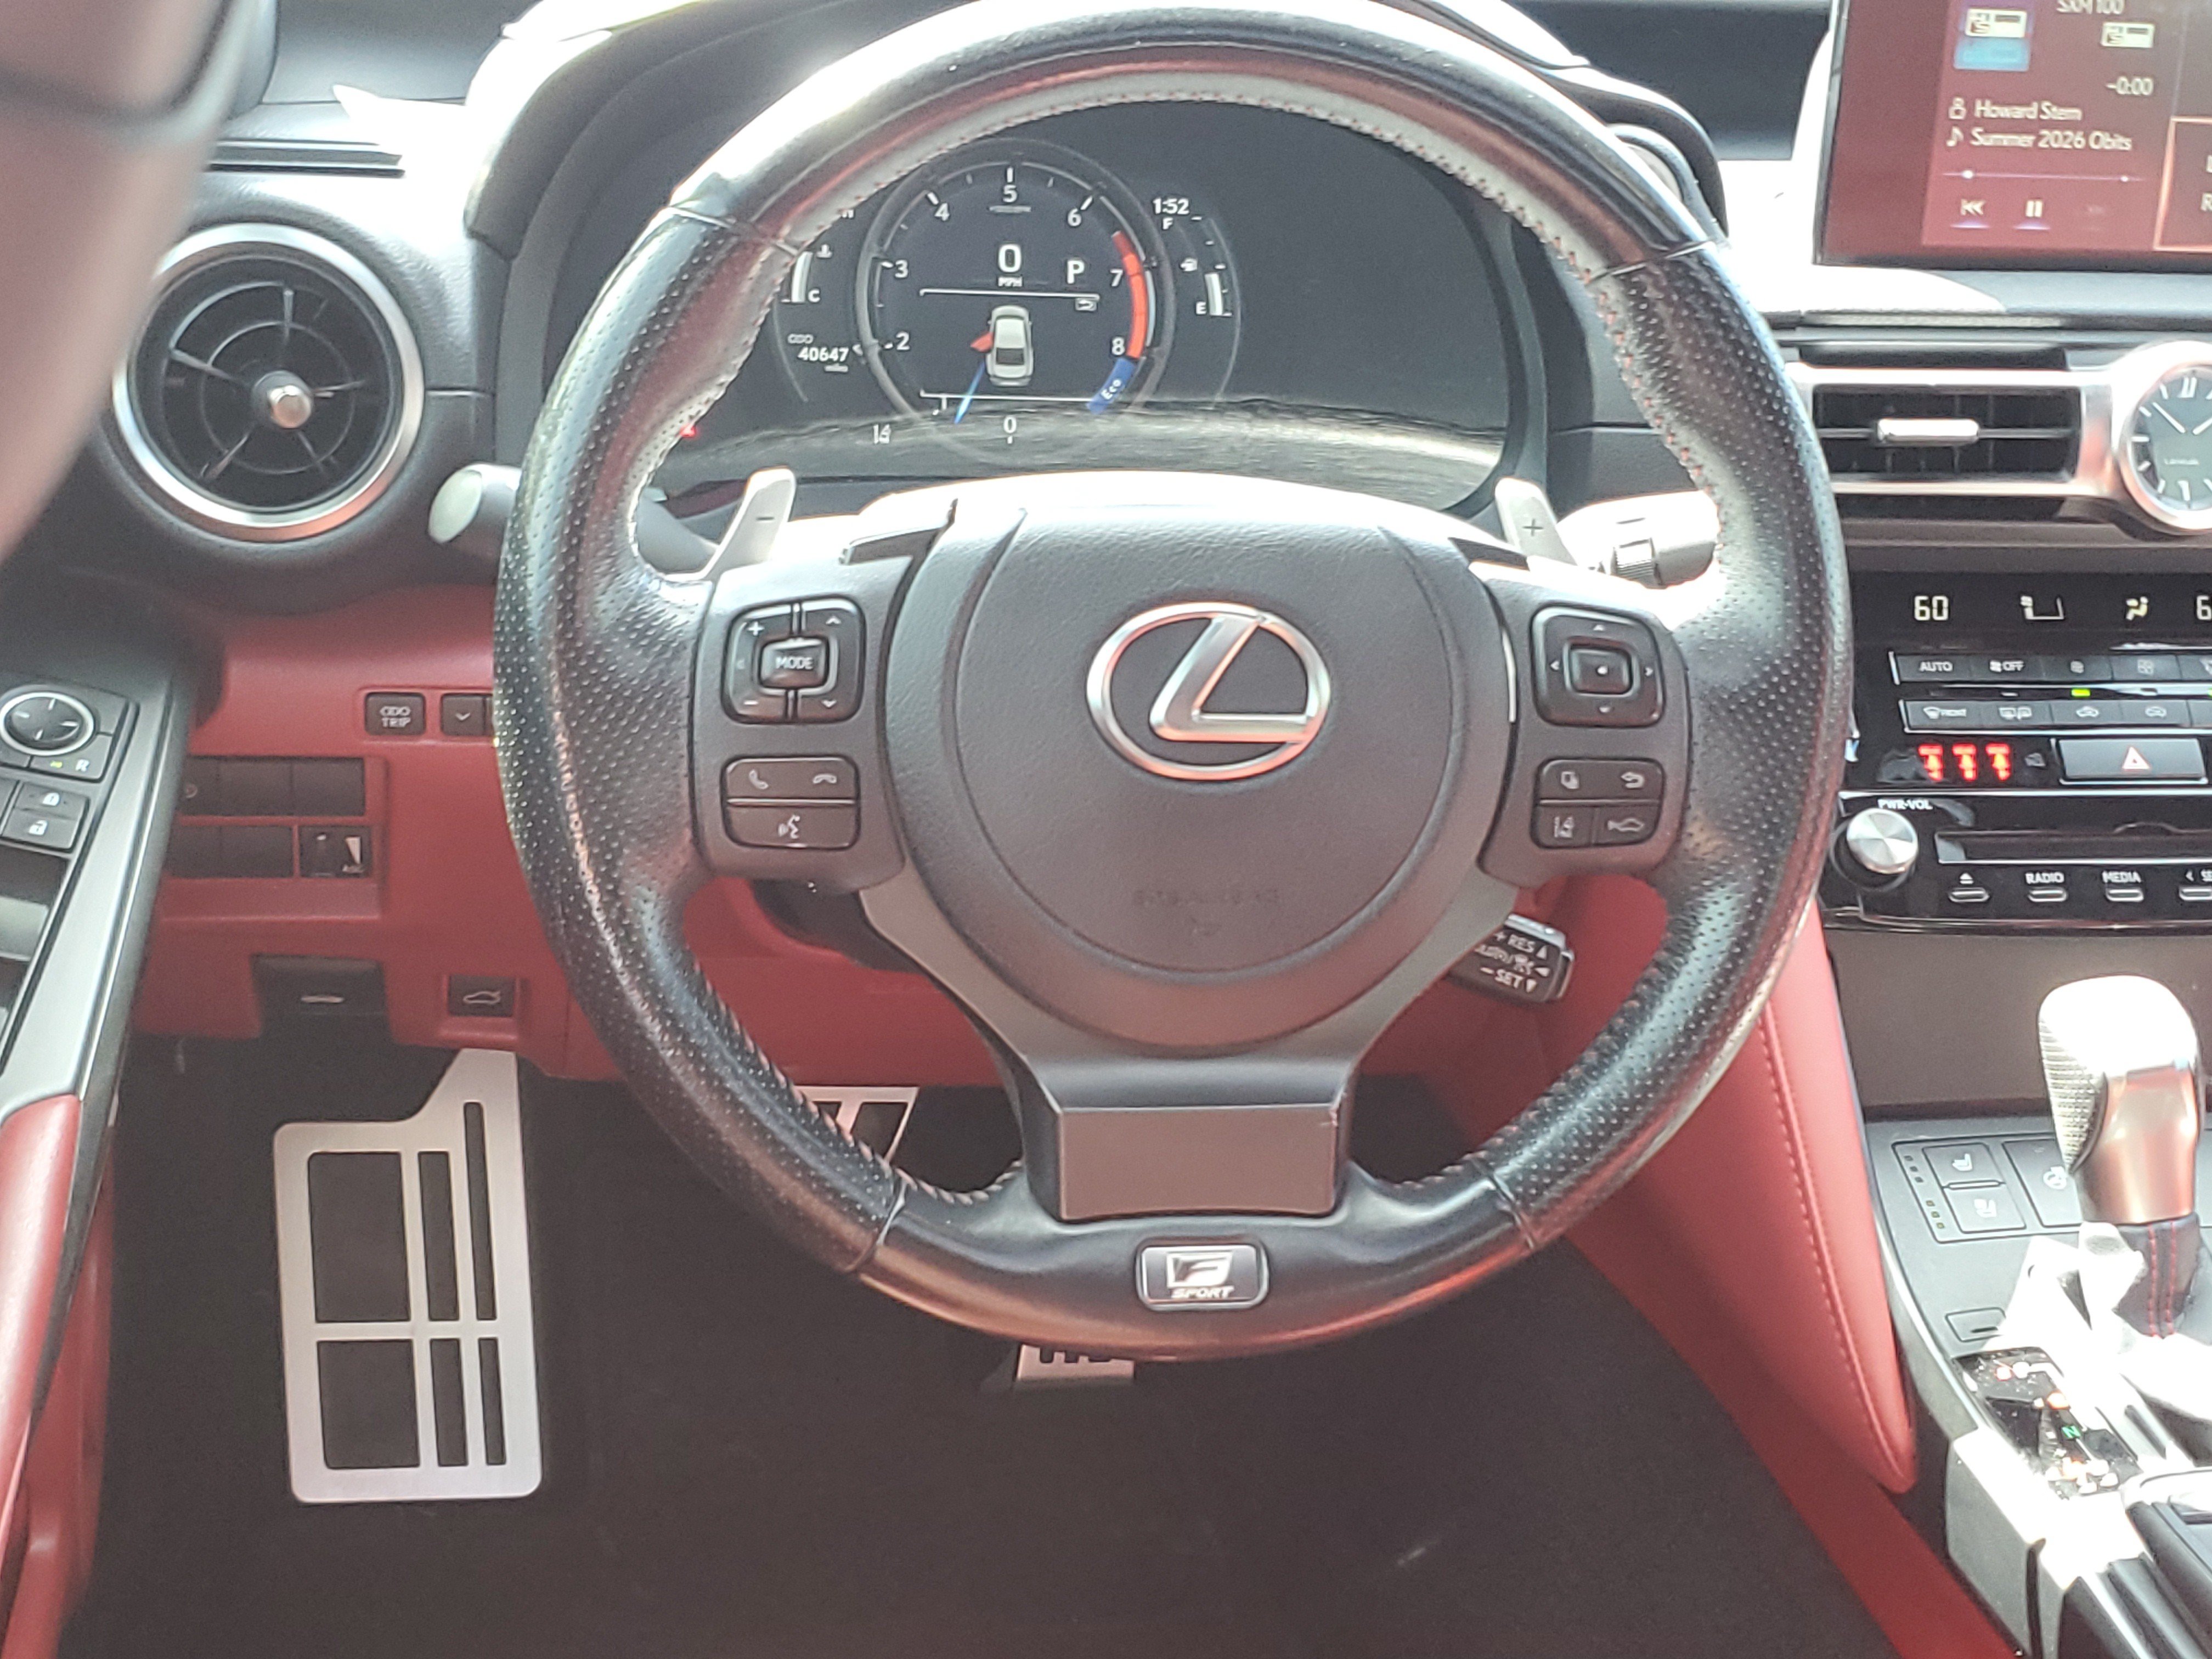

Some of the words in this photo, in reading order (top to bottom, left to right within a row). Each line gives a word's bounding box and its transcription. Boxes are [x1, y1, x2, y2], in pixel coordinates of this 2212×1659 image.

[1974, 99, 2038, 119] Howard
[2039, 100, 2083, 121] Stern
[1970, 127, 2036, 148] Summer
[2038, 129, 2086, 149] 2026
[2089, 131, 2132, 151] Obits
[1002, 184, 1018, 202] 5
[934, 204, 950, 221] 4
[1067, 209, 1082, 226] 6
[1163, 217, 1173, 230] F
[998, 244, 1022, 273] 0
[895, 260, 909, 278] 3
[1066, 260, 1085, 284] P
[1110, 269, 1124, 287] 7
[809, 289, 821, 303] C
[1195, 302, 1206, 315] E
[895, 332, 910, 351] 2
[1111, 337, 1125, 356] 8
[797, 347, 849, 362] 40647
[1003, 417, 1017, 433] 0
[1914, 595, 1949, 621] 60
[775, 656, 814, 670] MODE
[1919, 661, 1953, 672] AUTO
[2002, 661, 2025, 672] OFF
[380, 706, 411, 716] ODO
[381, 716, 411, 728] TRIP
[2025, 871, 2065, 884] RADIO
[2102, 871, 2142, 884] MEDIA
[1494, 968, 1523, 988] SET
[1171, 1286, 1234, 1299] SPORT
